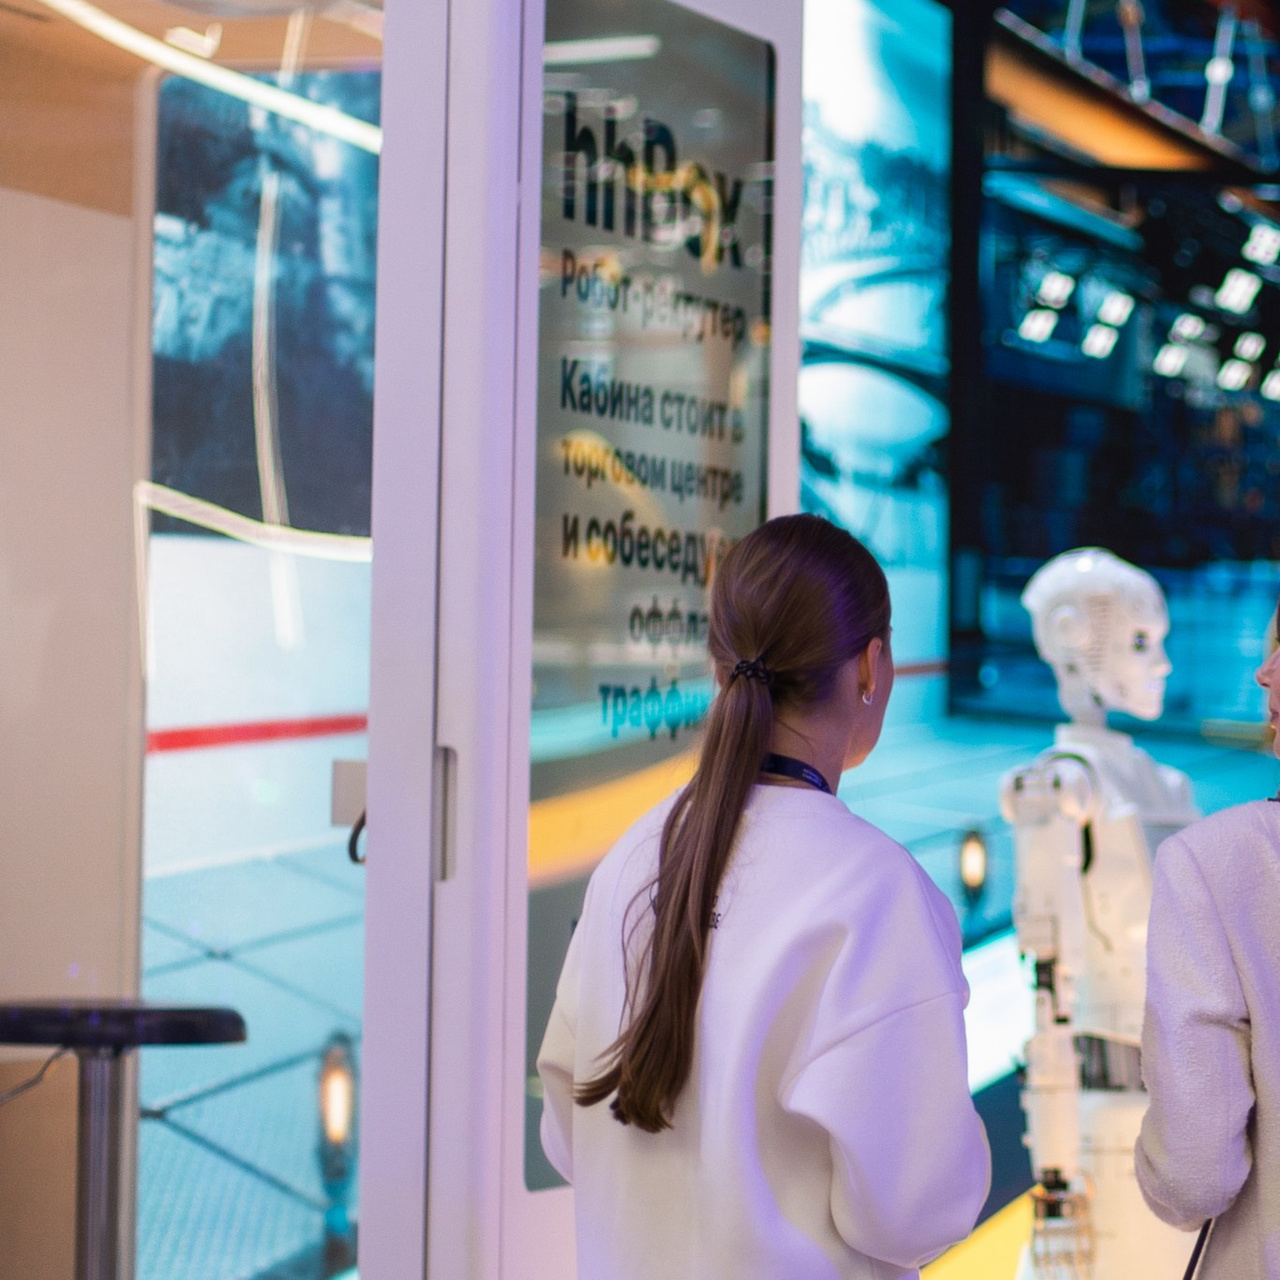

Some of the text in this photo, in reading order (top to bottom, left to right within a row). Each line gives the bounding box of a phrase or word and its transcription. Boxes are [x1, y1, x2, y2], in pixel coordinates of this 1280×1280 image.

[560, 355, 654, 428] Кабина
[660, 389, 729, 443] стоит
[561, 437, 744, 512] торговом центре
[562, 513, 580, 559] и
